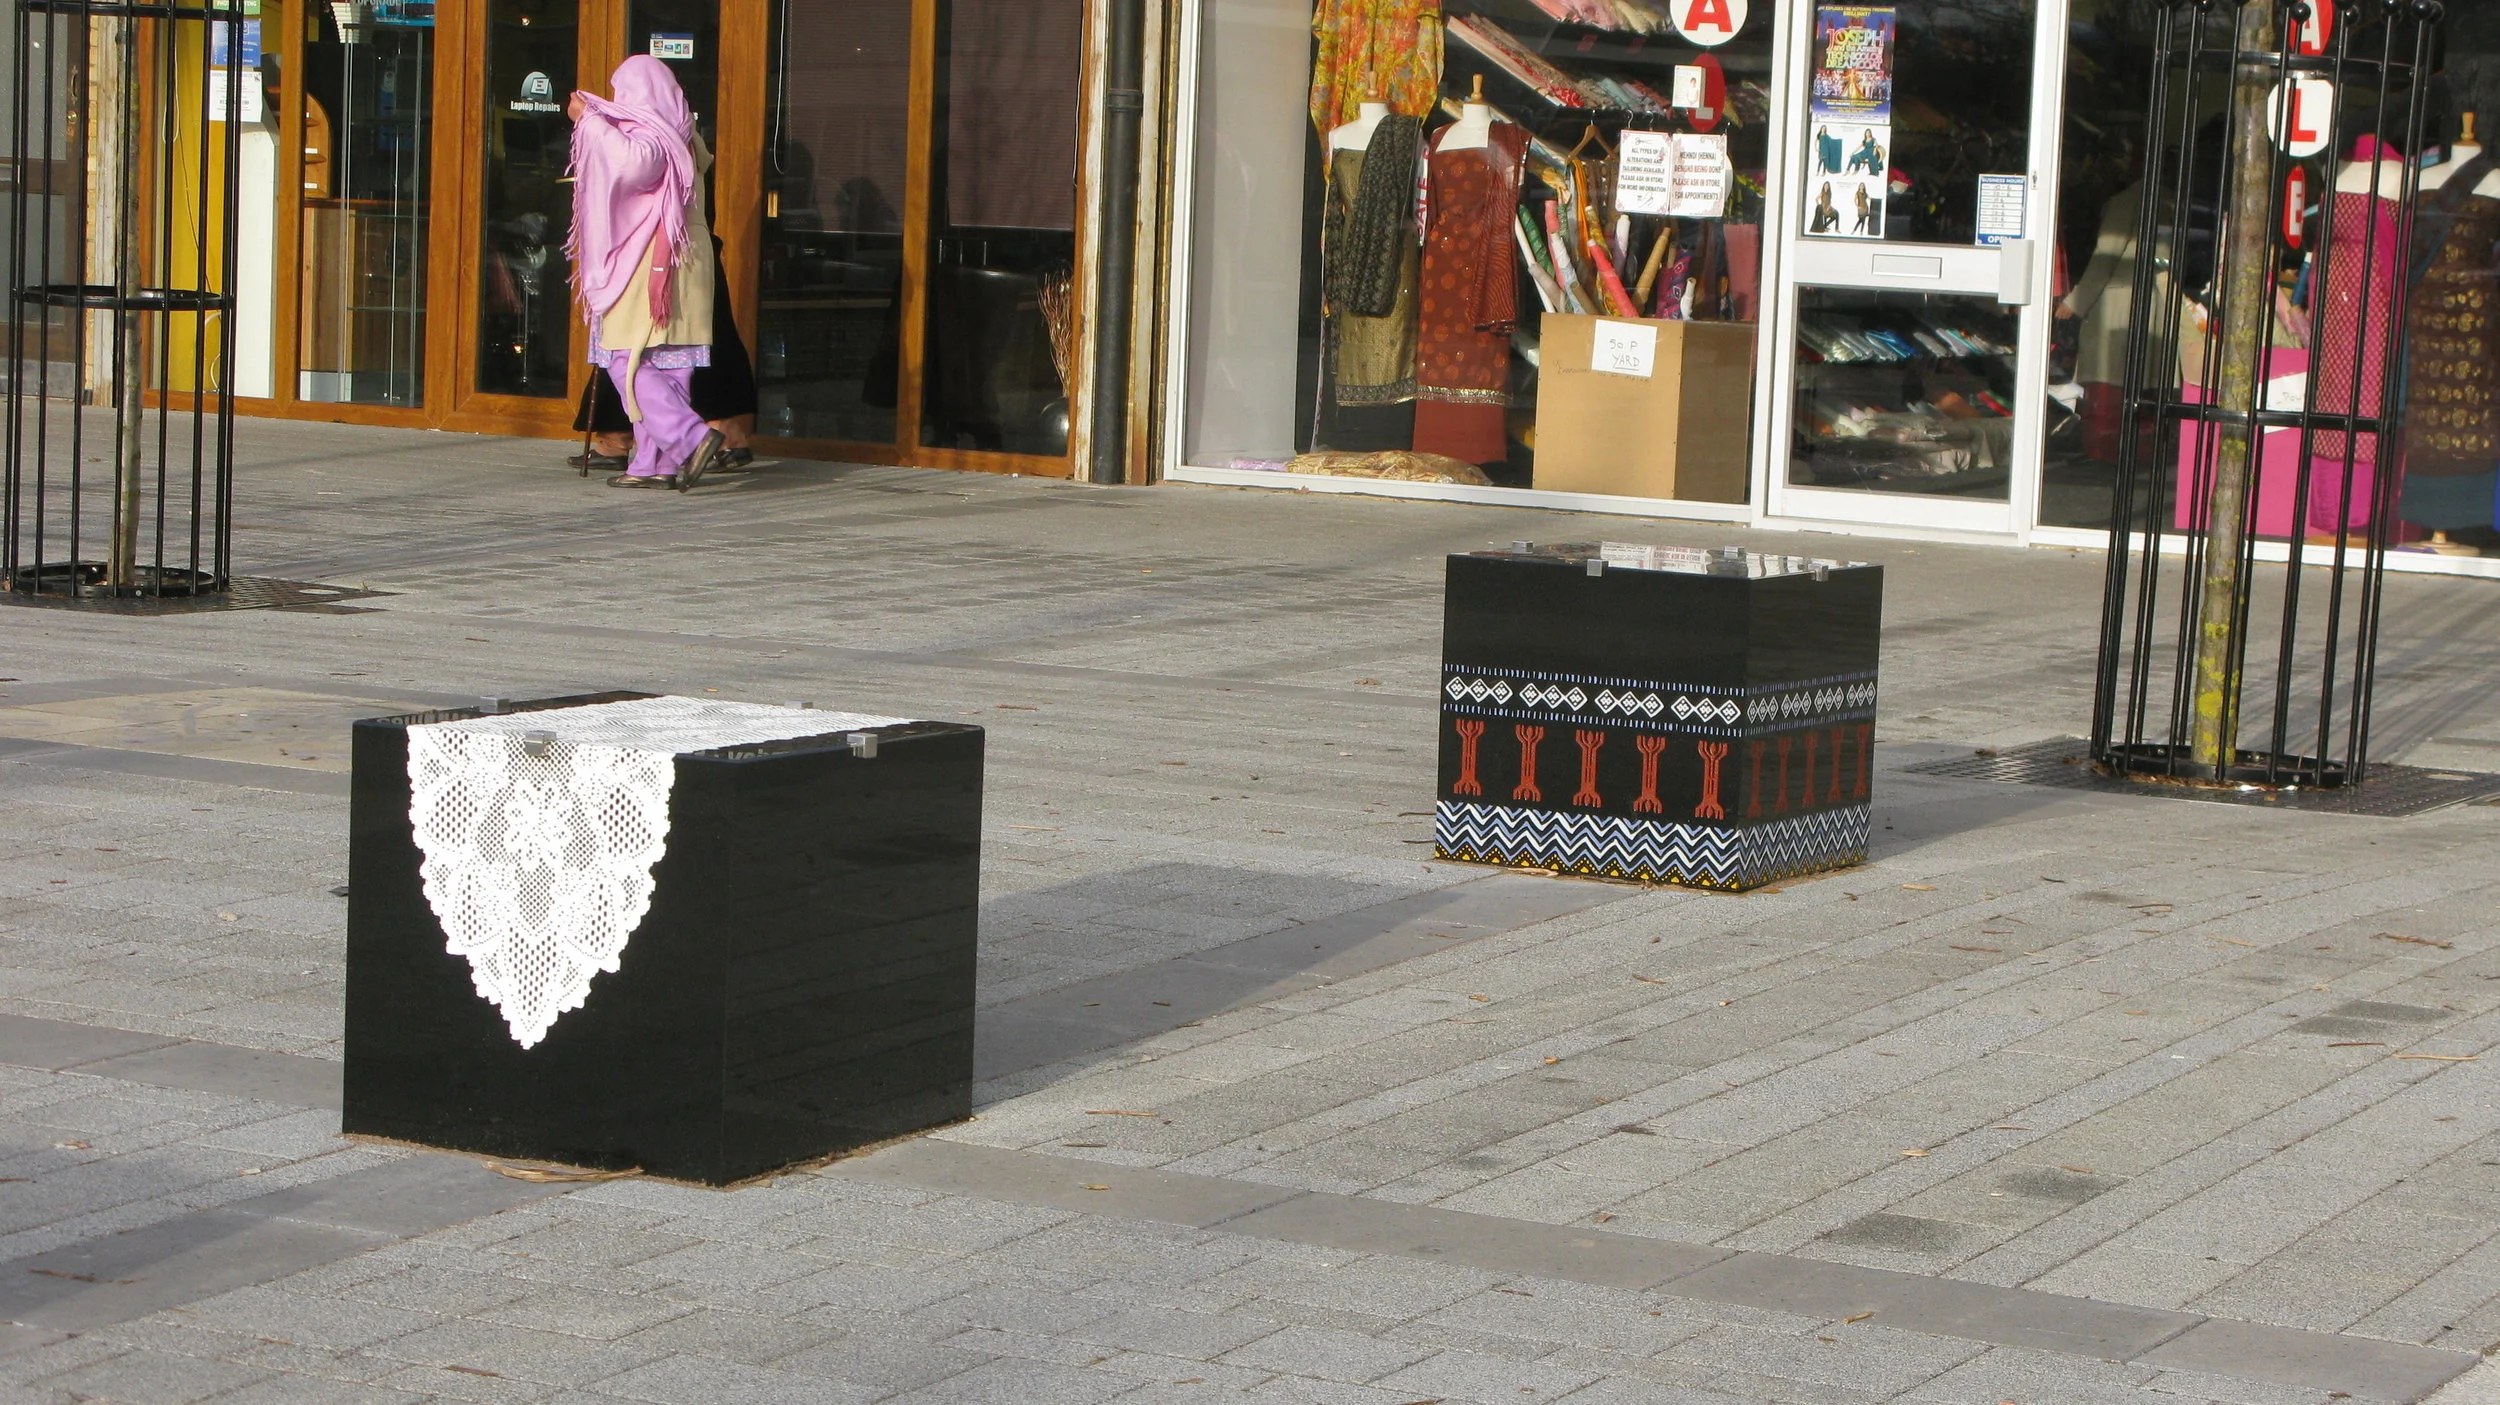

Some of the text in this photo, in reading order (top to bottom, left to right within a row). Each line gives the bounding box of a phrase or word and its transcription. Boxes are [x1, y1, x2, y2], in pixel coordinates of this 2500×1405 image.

[1826, 28, 1885, 50] JOSEPH
[511, 100, 561, 112] Laptop Repairs
[1612, 353, 1640, 368] YARD
